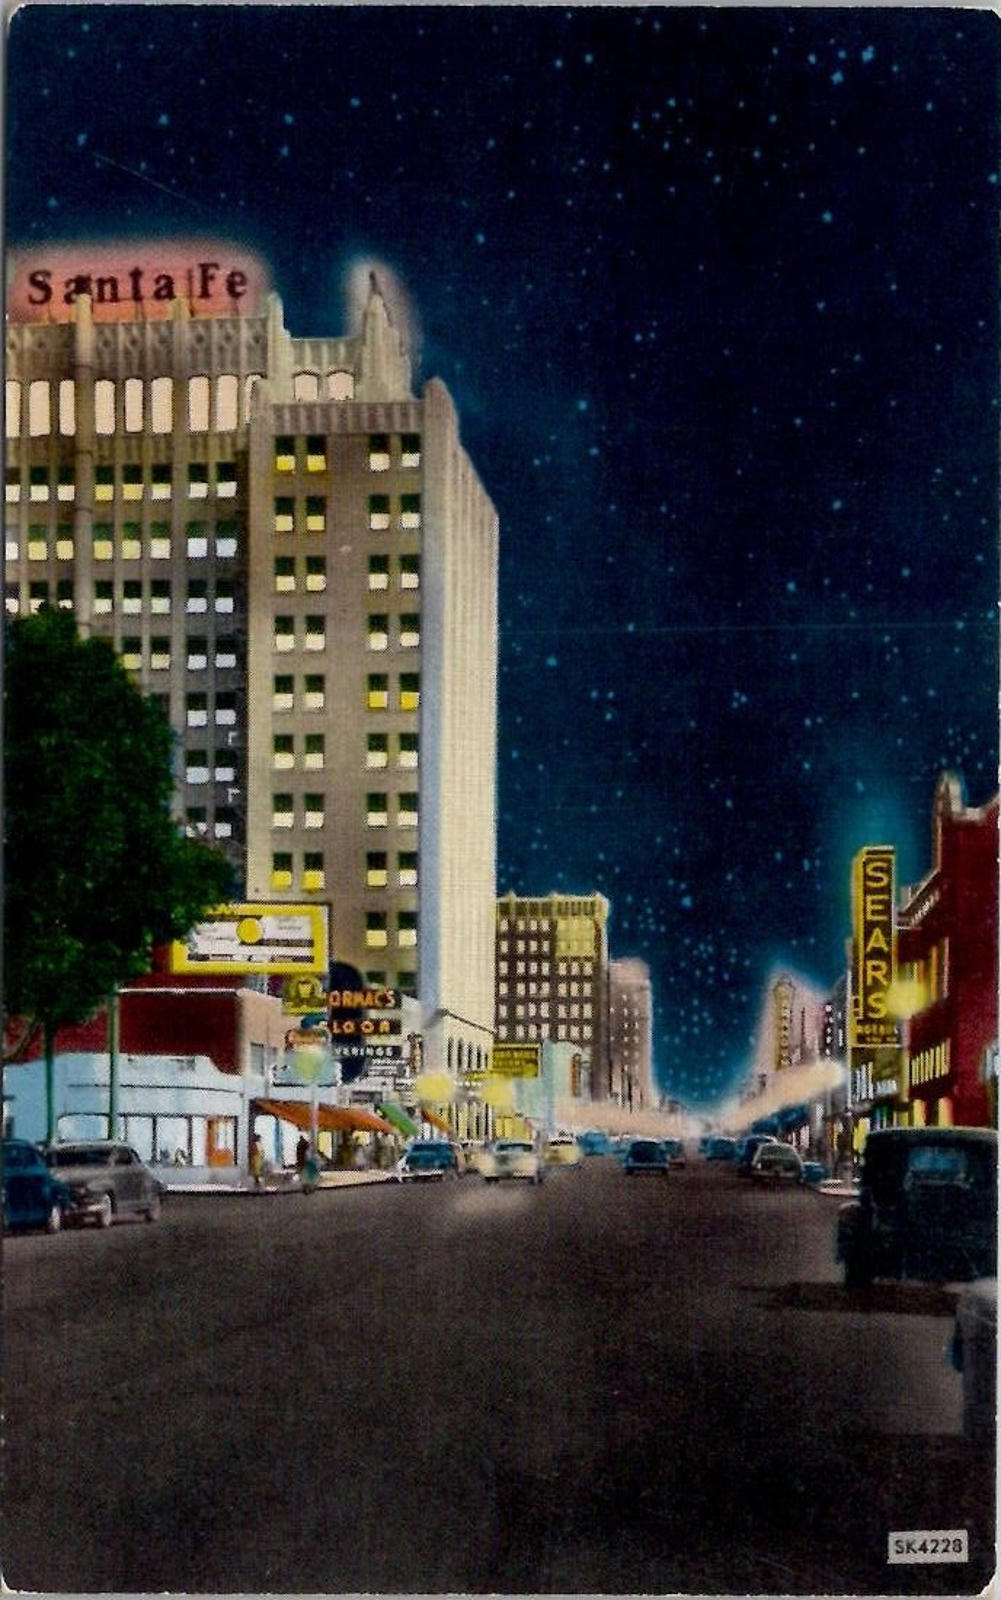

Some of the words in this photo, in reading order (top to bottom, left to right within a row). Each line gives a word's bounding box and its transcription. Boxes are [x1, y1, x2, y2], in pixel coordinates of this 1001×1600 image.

[28, 266, 177, 305] Santa
[198, 262, 248, 299] Fe
[865, 861, 890, 1019] SEARS
